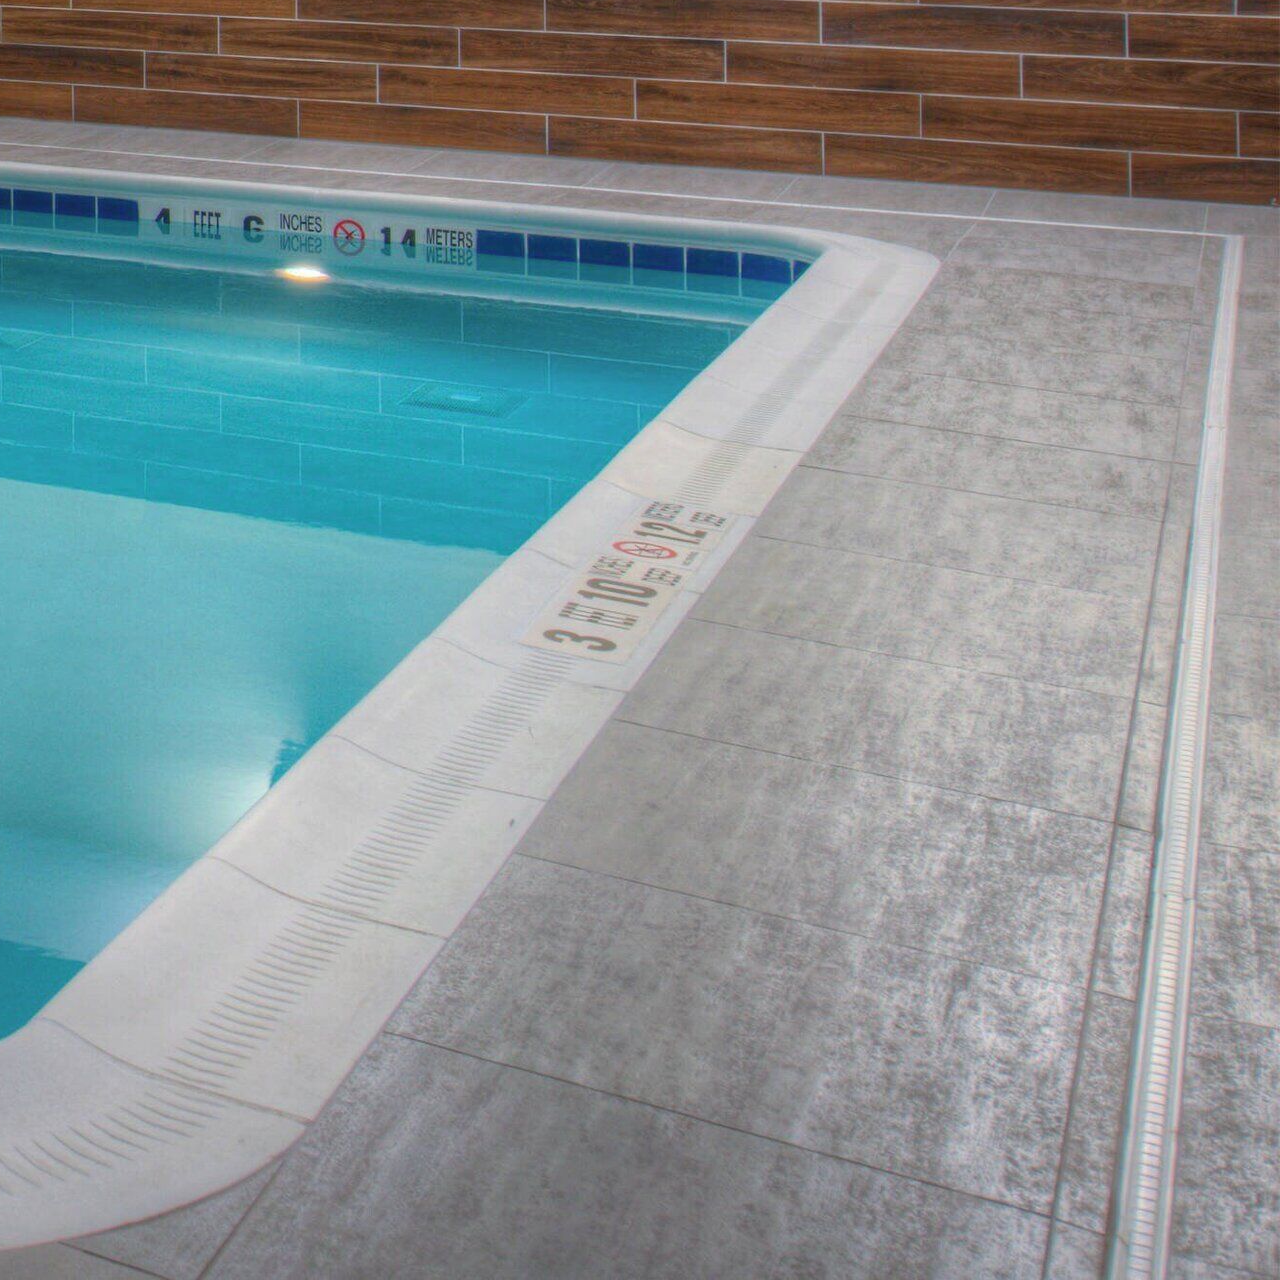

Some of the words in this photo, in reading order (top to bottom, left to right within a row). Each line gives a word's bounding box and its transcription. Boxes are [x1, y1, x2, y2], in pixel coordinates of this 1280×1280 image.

[280, 213, 323, 233] INCHES
[426, 227, 474, 249] METERS
[577, 578, 658, 608] 10
[559, 601, 640, 630] FEET
[543, 629, 617, 652] 3
